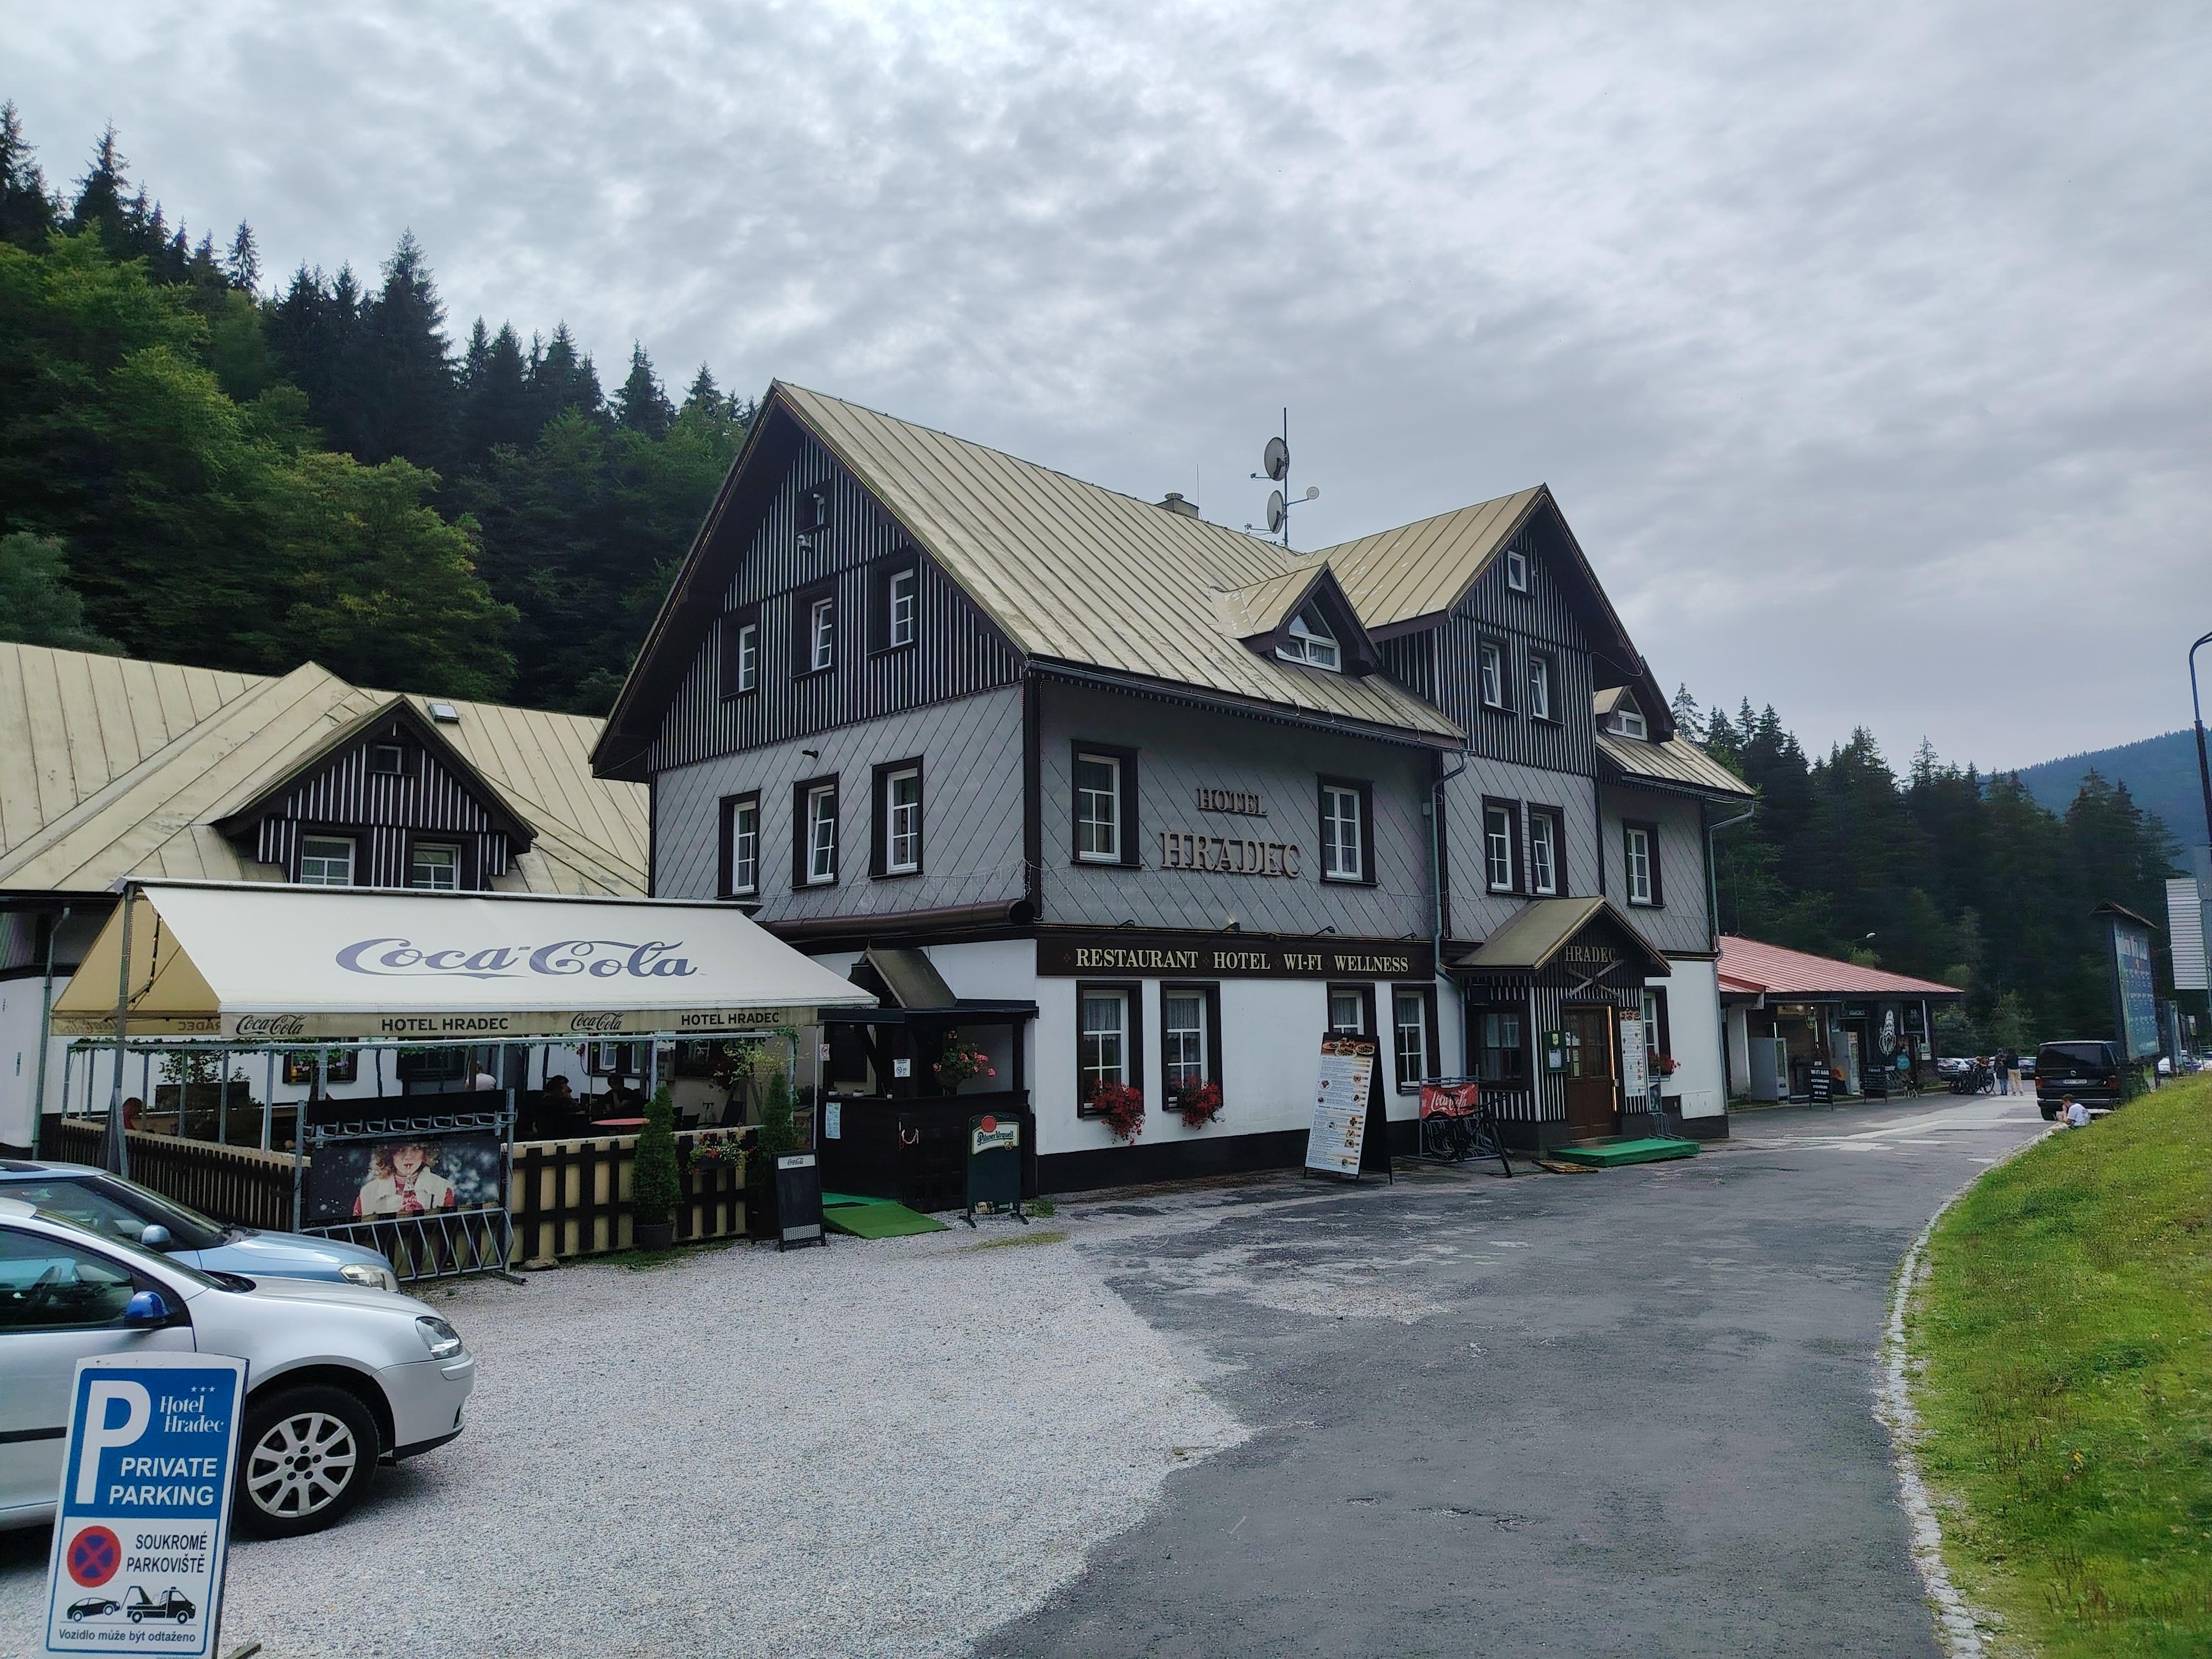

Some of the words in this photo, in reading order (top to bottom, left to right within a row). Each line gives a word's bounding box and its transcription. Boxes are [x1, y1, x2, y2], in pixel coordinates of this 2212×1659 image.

[1197, 787, 1269, 816] HOTEL
[1161, 831, 1301, 878] HRADEC
[336, 938, 698, 979] Coca-Cola
[1076, 948, 1198, 968] RESTAURANT
[1213, 952, 1271, 970] HOTEL
[1284, 953, 1322, 971] WI-FI
[1333, 955, 1409, 973] WELLNESS
[1565, 946, 1616, 963] HRADEC
[236, 1014, 307, 1035] Coca-Cola
[382, 1019, 437, 1031] HOTEL
[443, 1018, 509, 1030] HRADEC
[571, 1012, 624, 1031] Coca-Cola
[681, 1014, 724, 1025] HOTEL
[728, 1012, 780, 1024] HRADEC
[977, 1132, 996, 1146] Pilsner
[995, 1130, 1014, 1140] Urquell
[159, 1395, 205, 1416] Hotel
[164, 1415, 224, 1433] Hradec
[76, 1380, 151, 1504] P
[121, 1457, 218, 1477] PRIVATE
[109, 1485, 214, 1506] PARKING
[135, 1531, 208, 1550] SOUKROMÉ
[127, 1554, 205, 1573] PARKOVIŠTĚ
[59, 1629, 95, 1640] Vozidlo
[98, 1630, 126, 1641] může
[129, 1630, 145, 1644] být
[148, 1631, 196, 1642] odtaženo
